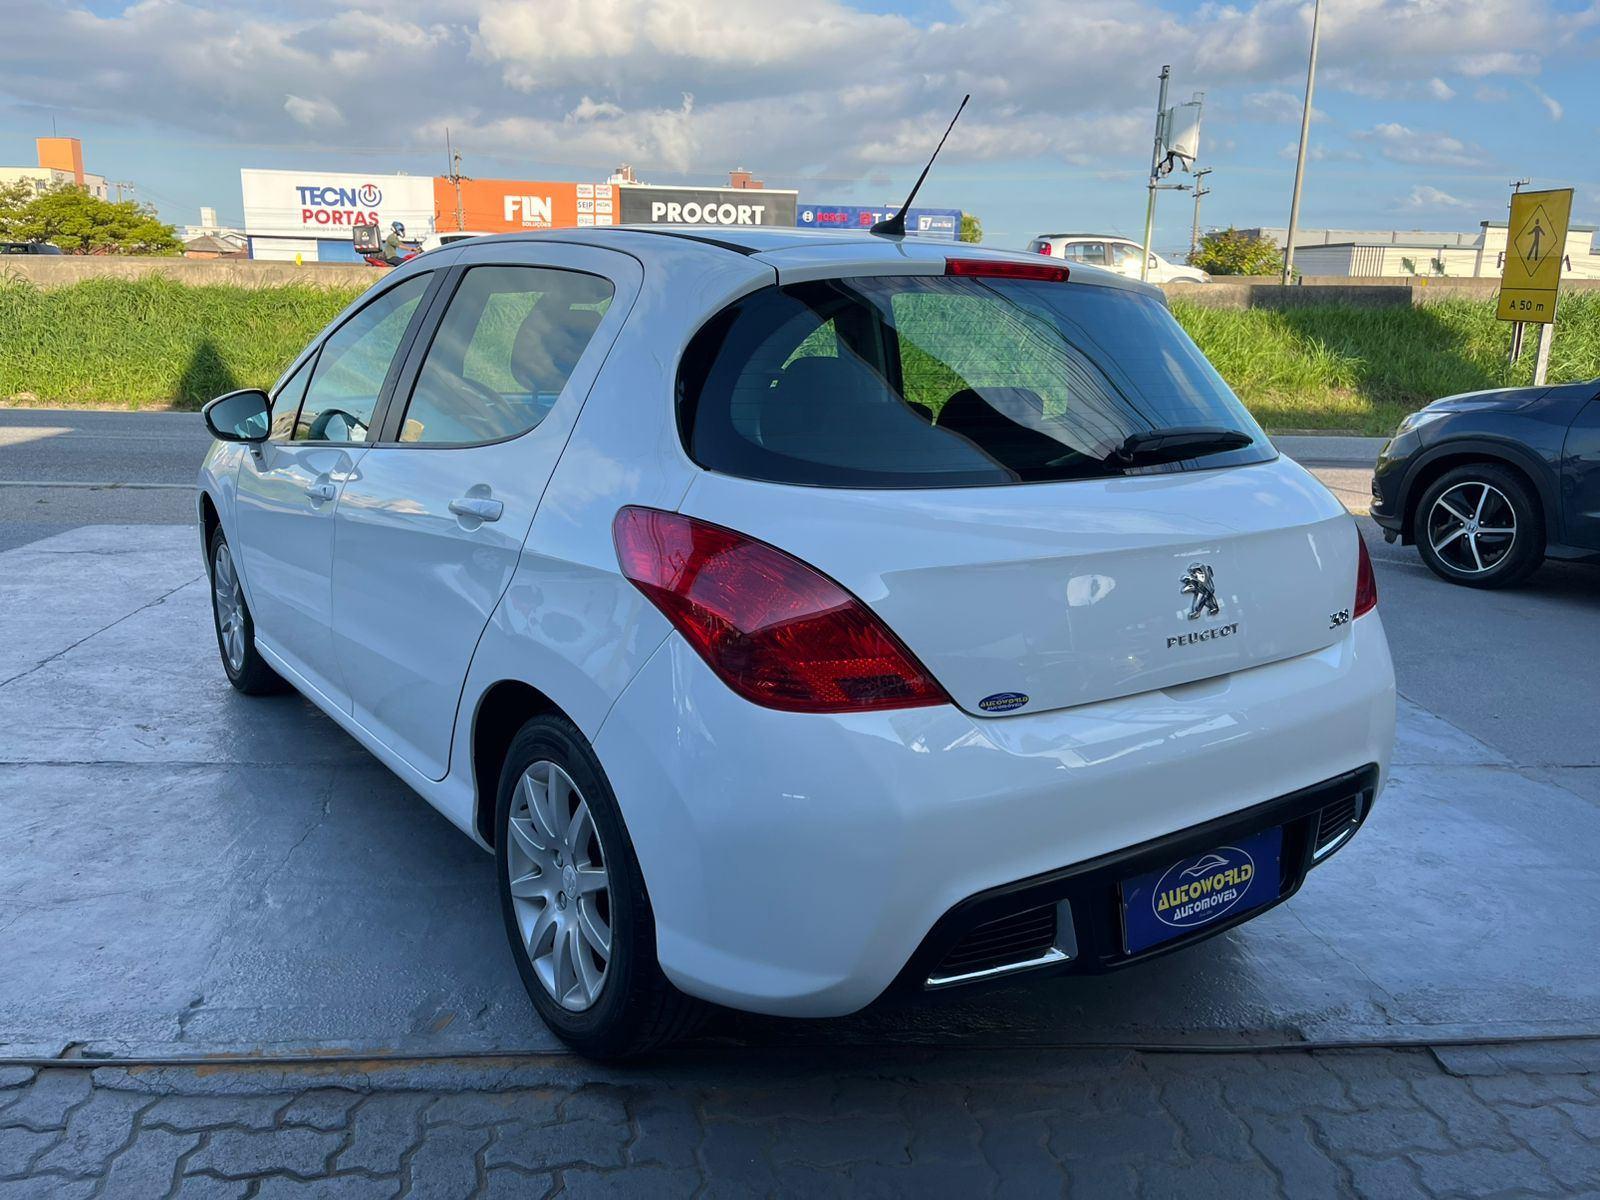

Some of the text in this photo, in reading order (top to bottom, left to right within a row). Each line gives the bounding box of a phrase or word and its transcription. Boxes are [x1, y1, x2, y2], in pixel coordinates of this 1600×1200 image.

[302, 209, 379, 225] PORTAS
[652, 202, 765, 225] PROCORT
[1510, 300, 1516, 310] A
[1520, 301, 1532, 311] 50
[1328, 608, 1349, 630] 308
[1166, 623, 1239, 649] PEUGEOT
[980, 696, 1028, 707] AUTOWORLD
[1157, 863, 1253, 911] AUTOWORLD
[1173, 888, 1238, 921] AUTOMÓVEIS
